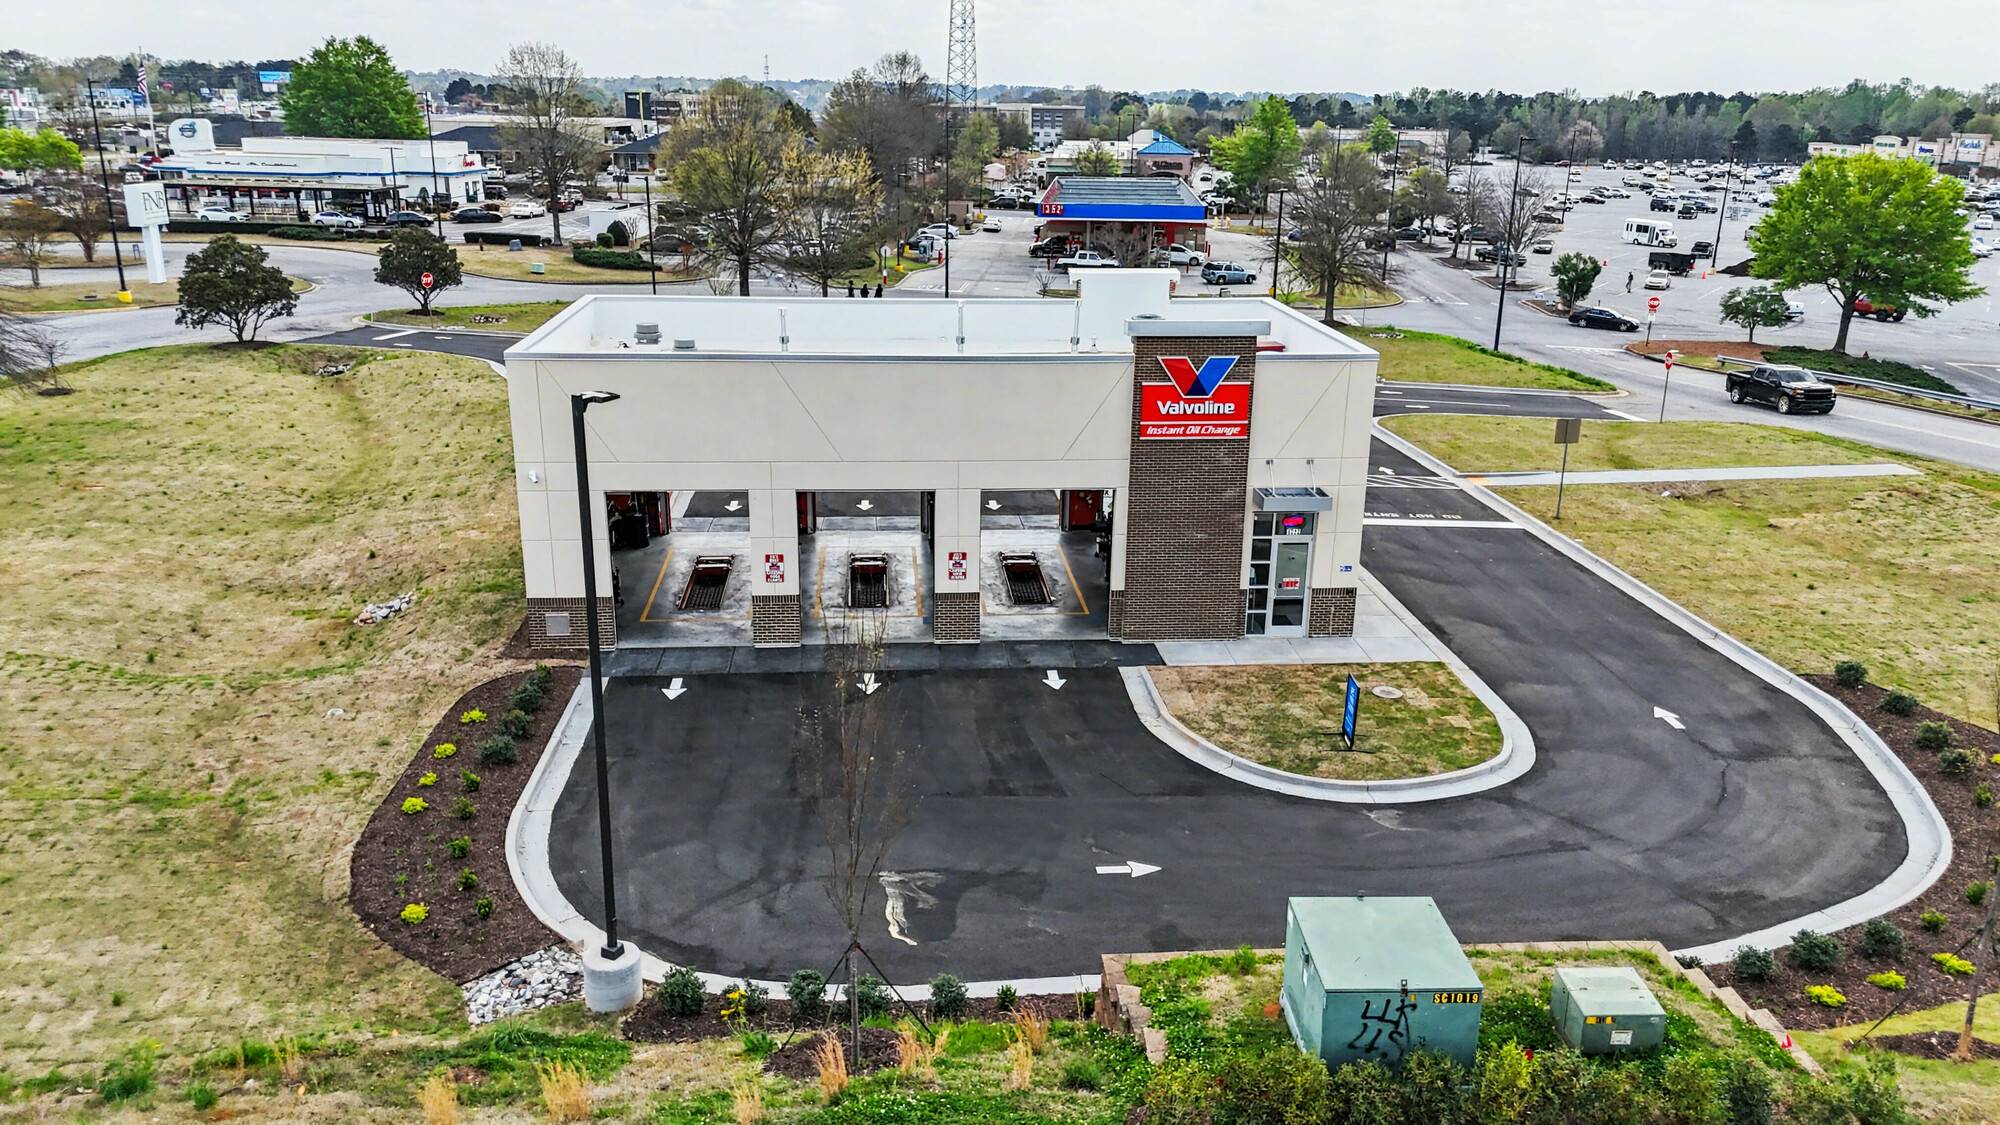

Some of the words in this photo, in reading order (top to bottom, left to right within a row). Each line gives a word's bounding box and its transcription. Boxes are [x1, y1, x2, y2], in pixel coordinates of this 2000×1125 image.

[1157, 400, 1236, 415] Valvoline
[1147, 426, 1184, 435] Instant
[1186, 426, 1201, 435] Oil
[1201, 425, 1241, 436] Change
[1434, 993, 1479, 1004] SC1019
